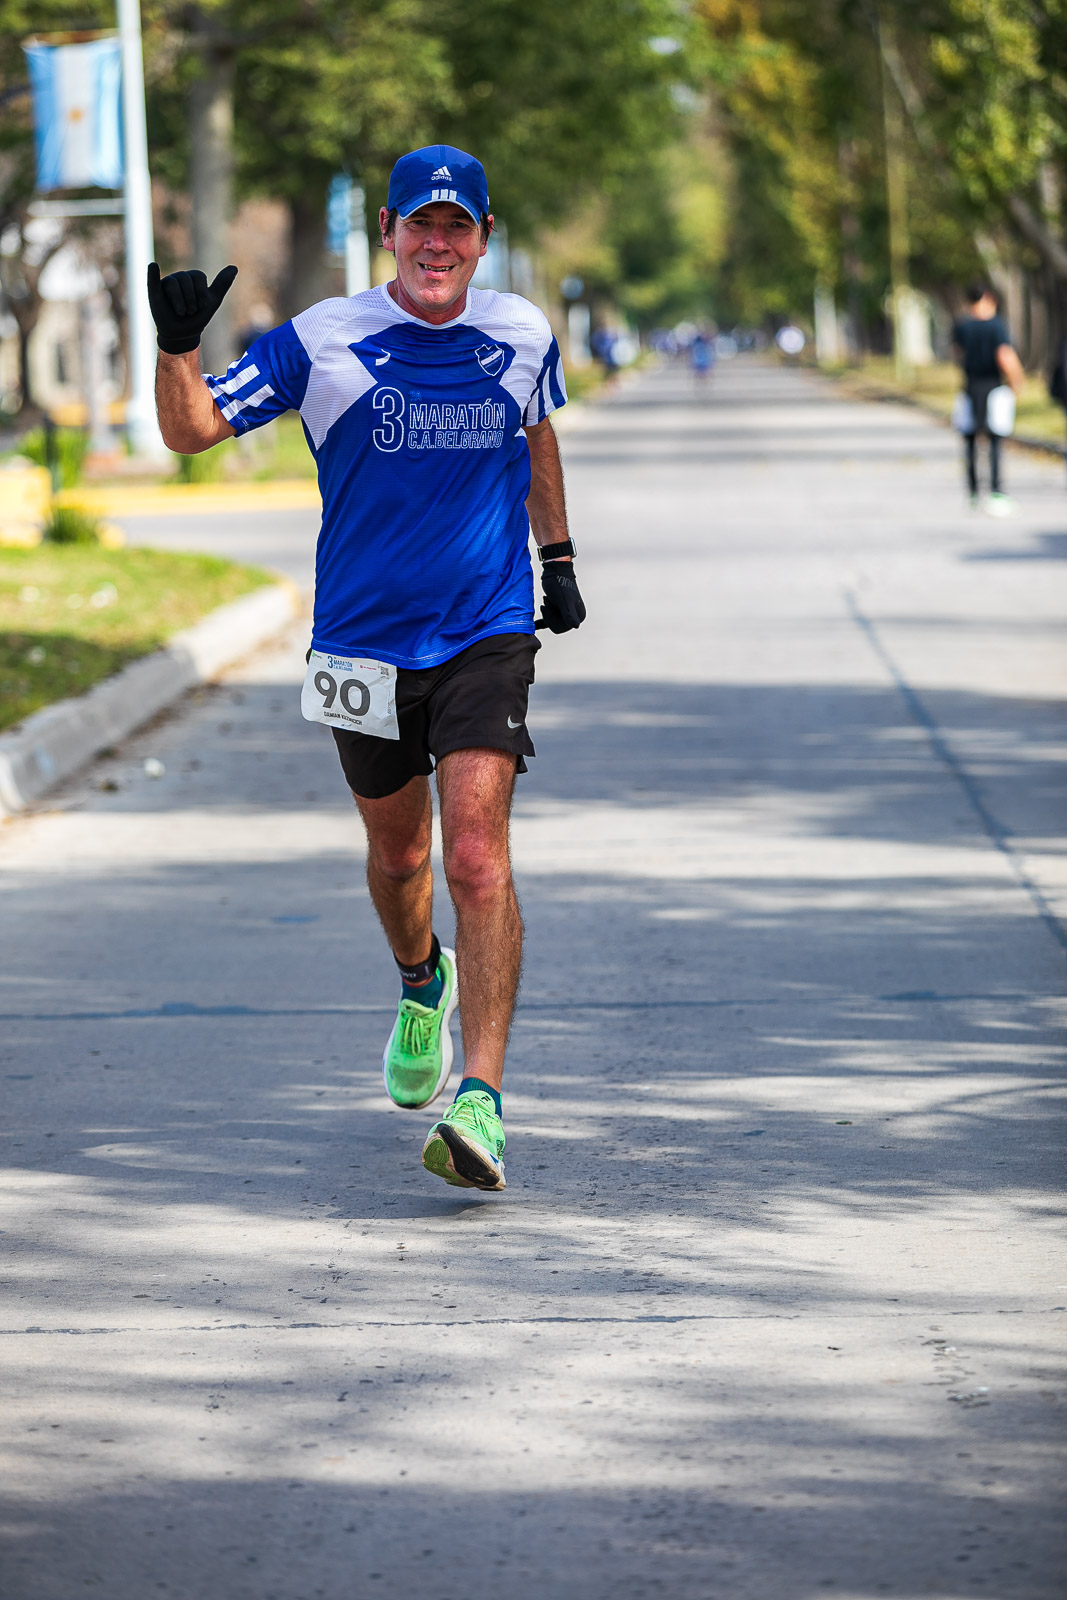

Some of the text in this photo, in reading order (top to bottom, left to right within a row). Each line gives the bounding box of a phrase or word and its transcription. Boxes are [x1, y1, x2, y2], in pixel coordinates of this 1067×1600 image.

[372, 386, 405, 453] 3
[409, 398, 505, 430] MARATÓN
[314, 671, 370, 716] 90
